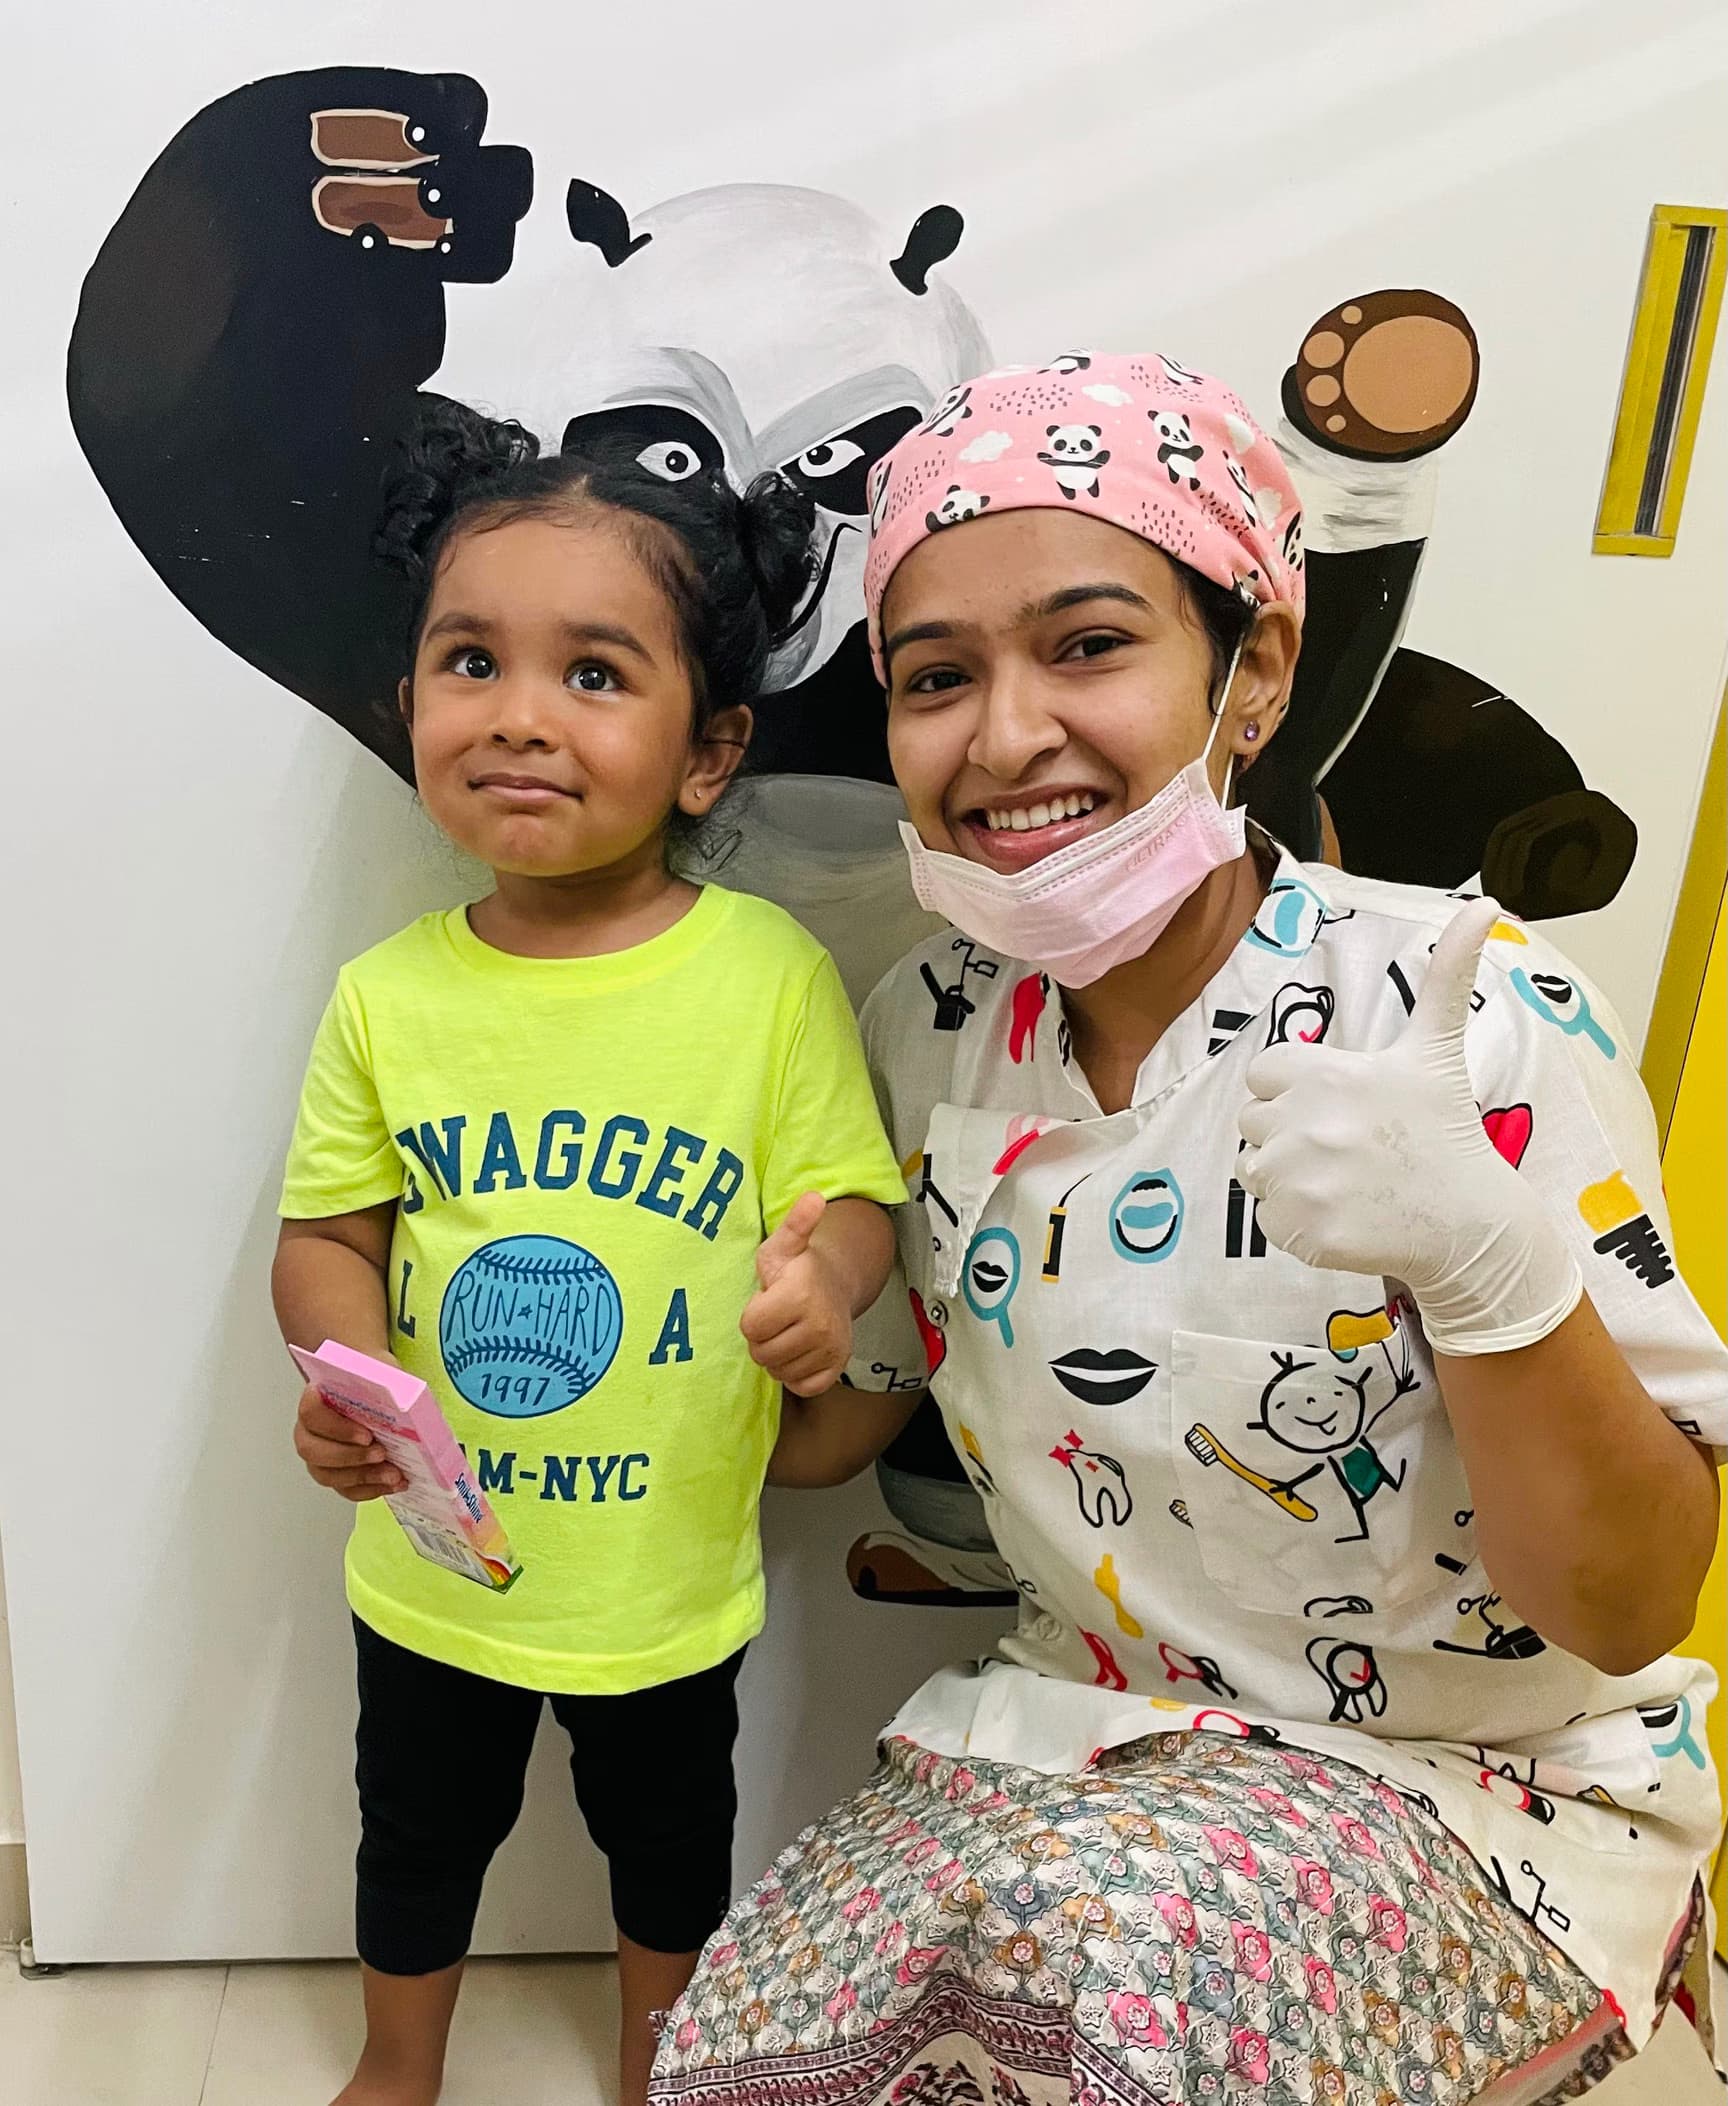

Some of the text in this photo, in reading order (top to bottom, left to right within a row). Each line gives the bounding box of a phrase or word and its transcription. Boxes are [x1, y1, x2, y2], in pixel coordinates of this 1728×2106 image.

[397, 1259, 416, 1339] L
[445, 1270, 613, 1357] RUN HARD
[648, 1287, 694, 1366] A
[481, 1373, 550, 1406] 1997
[458, 1443, 650, 1503] M-NYC
